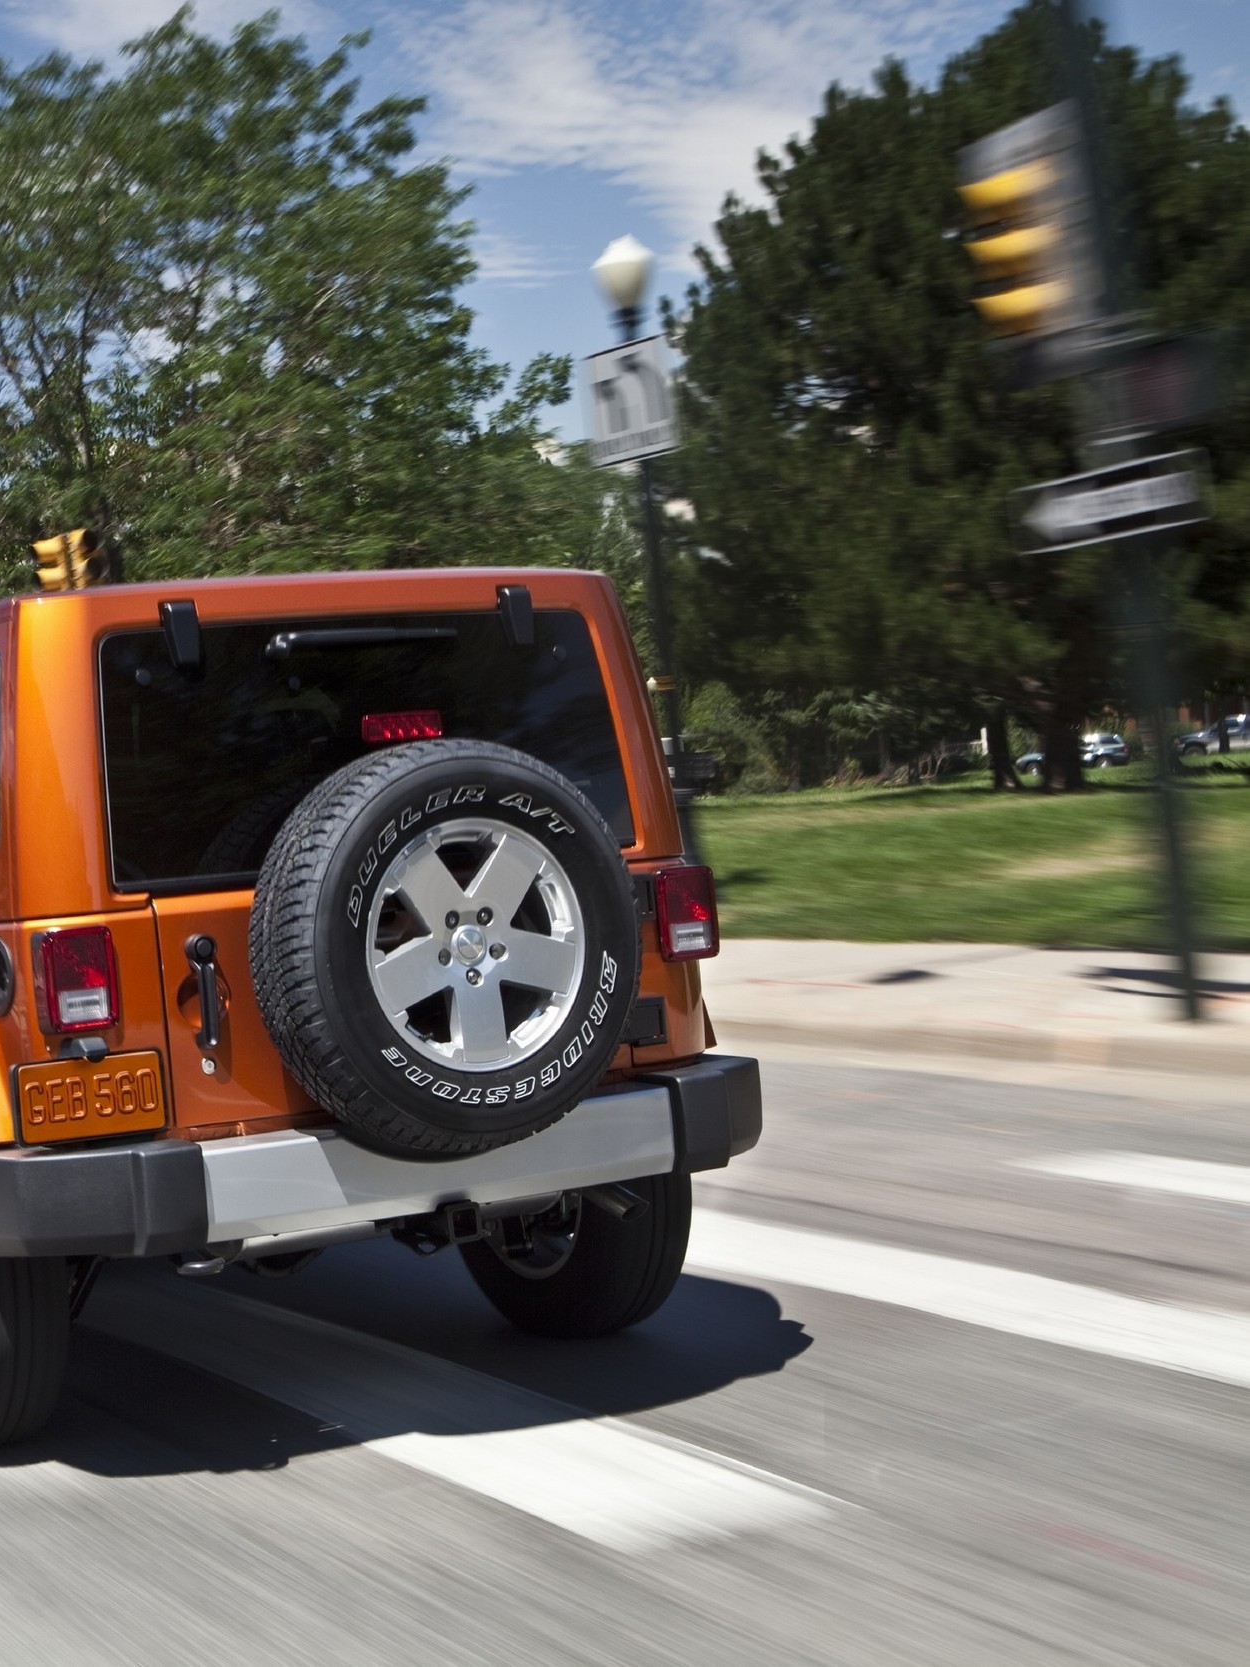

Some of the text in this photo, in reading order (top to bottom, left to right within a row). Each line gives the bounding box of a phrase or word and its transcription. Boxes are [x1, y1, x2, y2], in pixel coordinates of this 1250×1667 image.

[347, 784, 576, 928] DUELER A/T
[25, 1068, 159, 1125] GEB 560
[381, 950, 618, 1105] BRIDGESTONE
